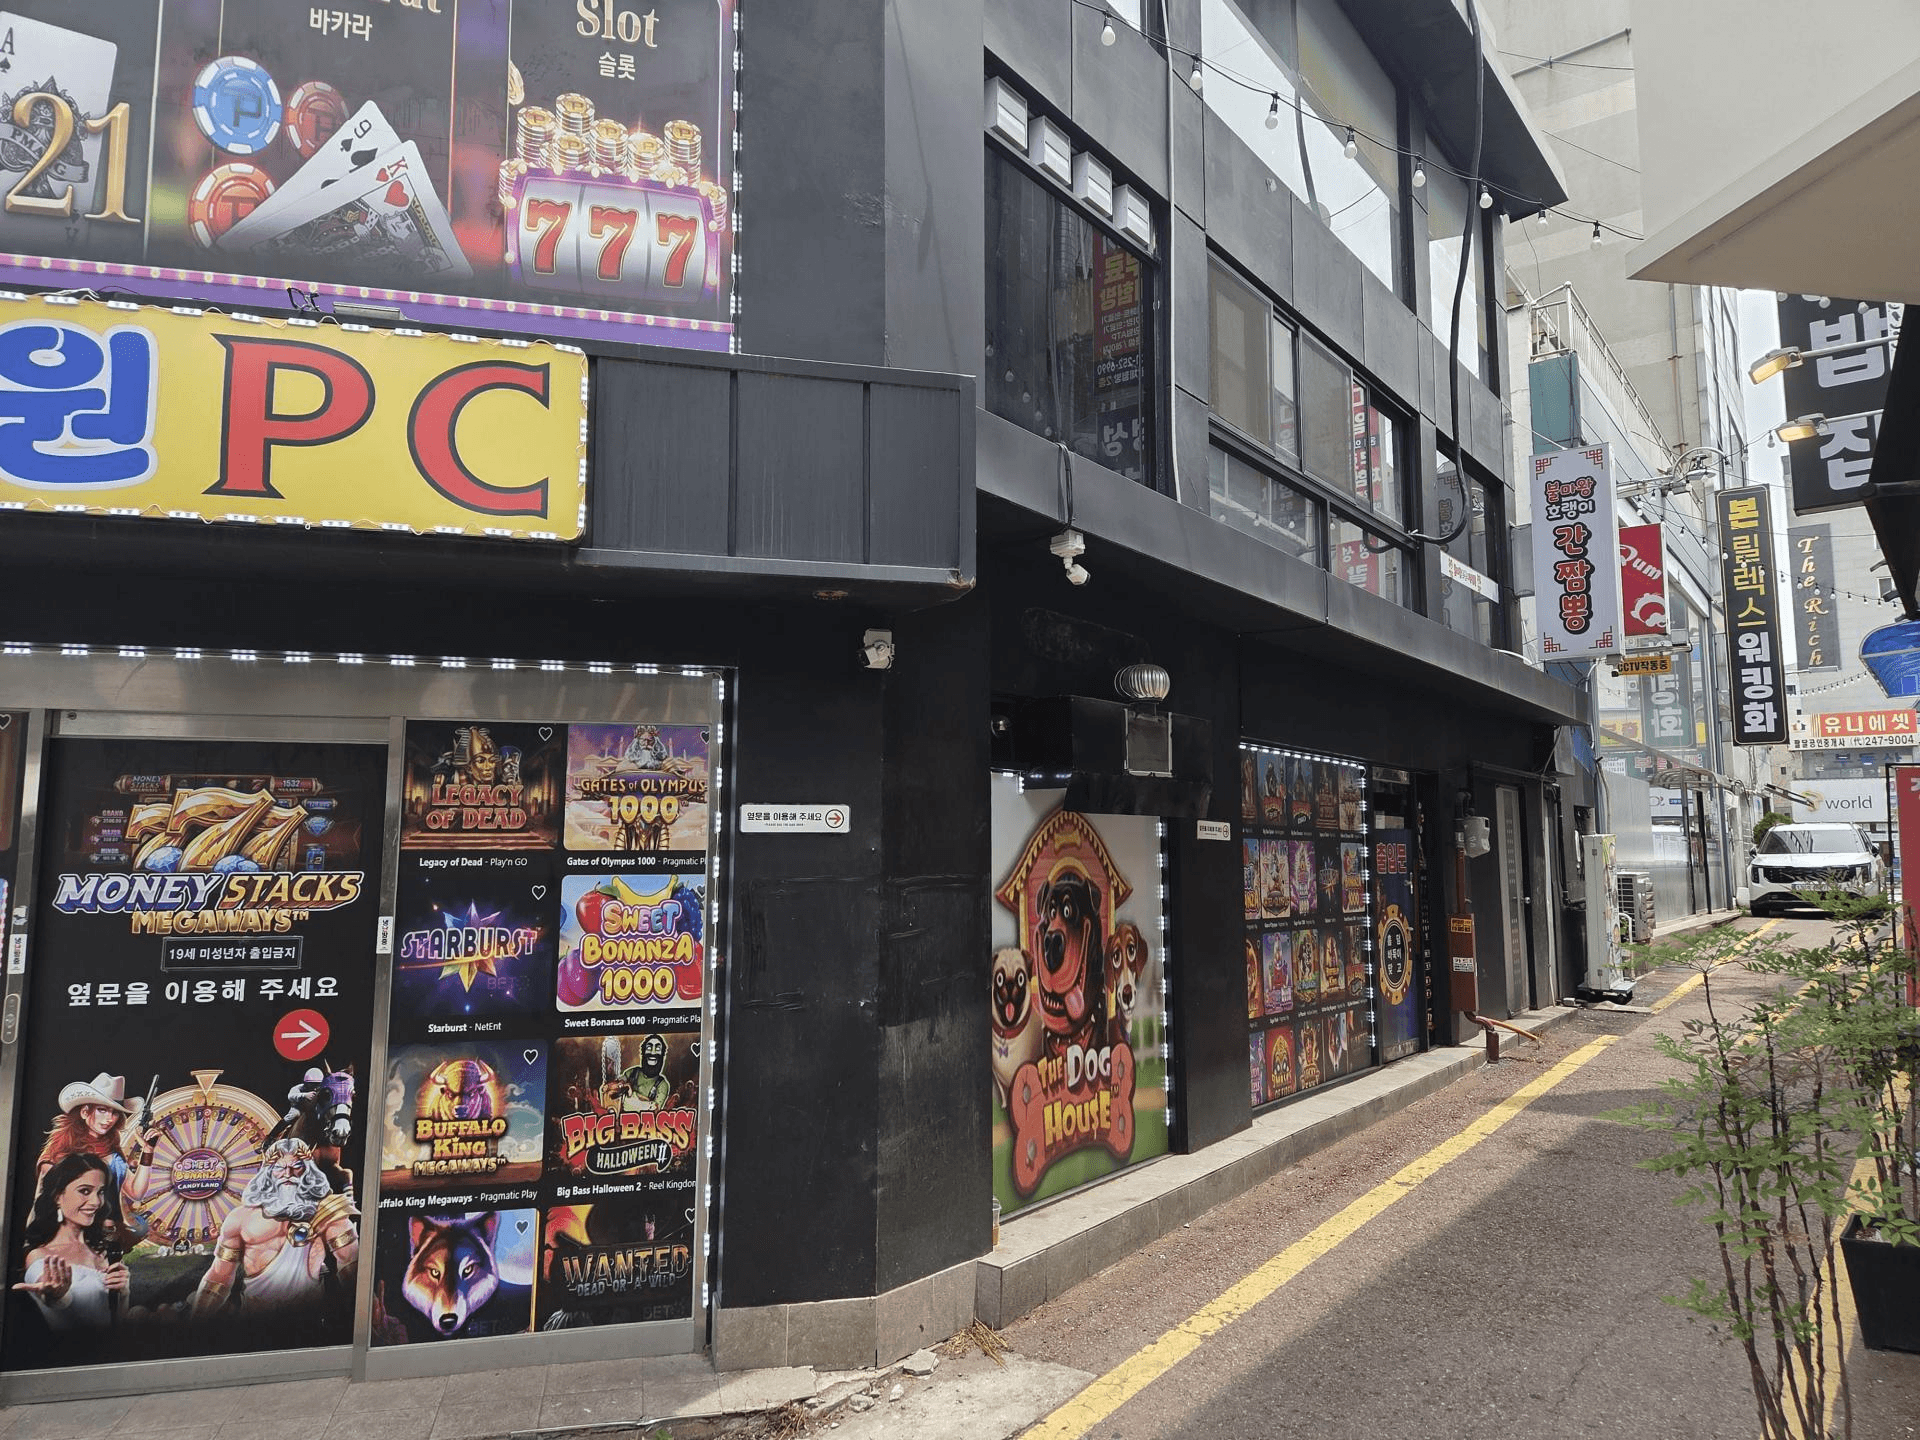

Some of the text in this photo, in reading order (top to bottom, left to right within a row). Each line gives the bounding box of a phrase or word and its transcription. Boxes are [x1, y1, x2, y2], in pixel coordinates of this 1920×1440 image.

[309, 7, 374, 42] 바카라
[576, 0, 660, 49] Slot
[597, 51, 637, 82] 슬롯
[5, 91, 142, 223] 21
[387, 155, 409, 178] K
[1545, 476, 1597, 504] 불마왕
[1546, 499, 1596, 521] 호랭이
[1797, 536, 1820, 588] The
[1554, 522, 1595, 635] 간짬뽕
[1824, 712, 1911, 734] 유니에셋
[431, 784, 524, 808] LEGACY
[580, 779, 707, 793] GATES of OLYMPUS
[608, 795, 680, 825] 1000
[1824, 795, 1873, 810] world
[425, 807, 527, 830] OF DEAD
[746, 812, 823, 821] 옆문을 이용해 주세요
[419, 857, 528, 868] Legacy of Dead Play'n GO
[566, 857, 590, 867] Gates
[591, 857, 600, 867] of
[600, 857, 636, 868] Olympus
[637, 856, 656, 866] 1000
[662, 856, 699, 868] Pragmatic
[1376, 842, 1407, 874] 출입문
[52, 871, 365, 914] MONEY STACKS
[601, 900, 682, 938] SWEET
[169, 946, 297, 961] 19세 미성년자 출입금지
[400, 928, 540, 959] STARBURST
[580, 933, 695, 968] BONANZA
[67, 976, 340, 1007] 옆문을 이용해 주세요
[599, 966, 678, 1004] 1000
[428, 1021, 502, 1033] Starburst NetEnt
[564, 1018, 589, 1028] Sweet
[591, 1017, 624, 1027] Bonanza
[625, 1016, 646, 1026] 1000
[652, 1015, 689, 1028] Pragmatic
[1037, 1043, 1111, 1089] THE DOG
[415, 1118, 507, 1143] BUFFALO
[562, 1109, 697, 1159] BIG BASS
[433, 1137, 487, 1158] KING
[596, 1143, 658, 1170] HALLOWEEN
[403, 1196, 426, 1208] King
[427, 1194, 473, 1207] Megaways
[480, 1191, 519, 1203] Pragmatic
[521, 1189, 538, 1201] Play
[556, 1186, 570, 1198] Big
[571, 1185, 591, 1195] Bass
[592, 1182, 634, 1195] Halloween
[634, 1182, 642, 1192] 2
[648, 1181, 664, 1191] Reel
[562, 1245, 689, 1288] WANTED
[577, 1281, 606, 1297] DEAD
[612, 1278, 627, 1292] OR
[648, 1272, 676, 1288] WILD
